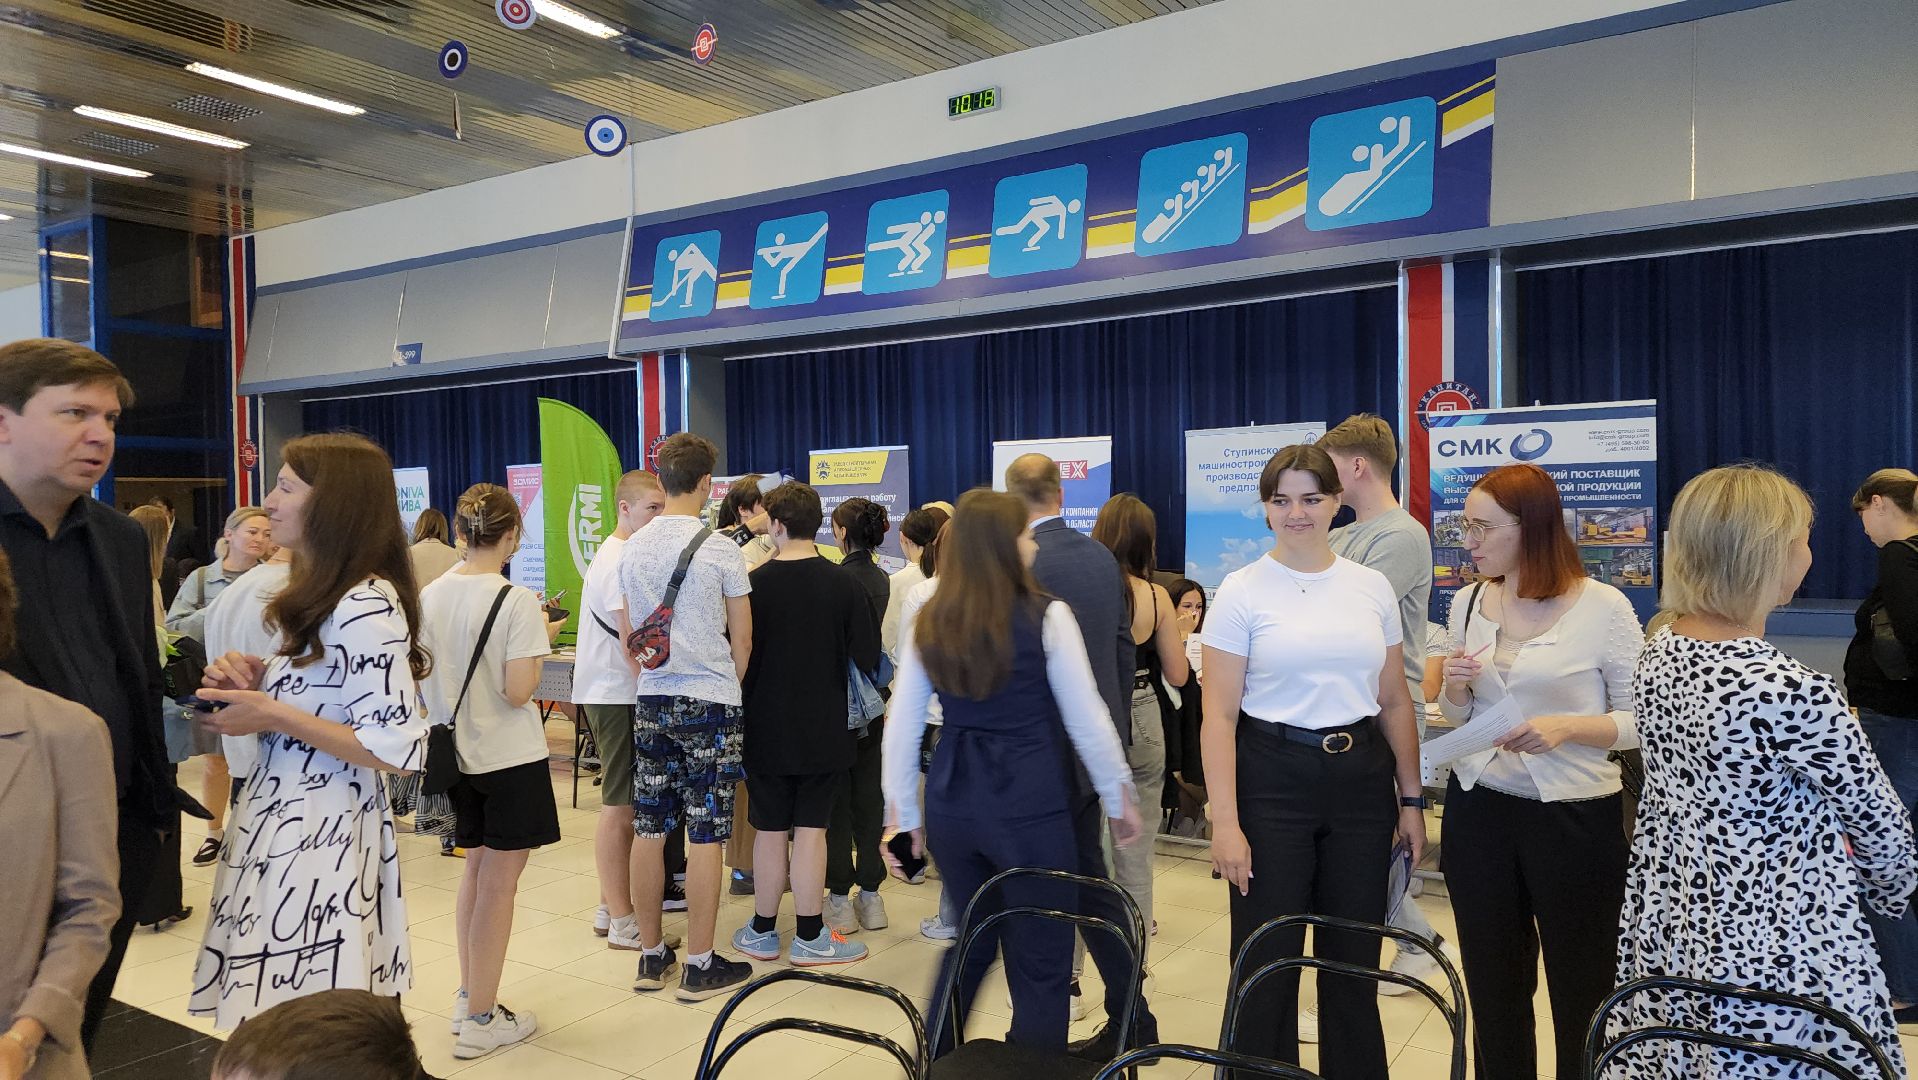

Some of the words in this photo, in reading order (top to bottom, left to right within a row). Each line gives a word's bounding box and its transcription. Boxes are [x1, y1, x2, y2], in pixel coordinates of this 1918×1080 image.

[1437, 437, 1504, 458] СМК
[1570, 468, 1641, 479] ПОСТАВЩИК
[1577, 481, 1642, 492] ПРОДУКЦИИ
[870, 492, 897, 504] работу
[1563, 493, 1642, 502] ПРОМЫШЛЕННОСТИ
[1065, 507, 1098, 517] КОМПАНИЯ
[635, 646, 656, 666] FILA
